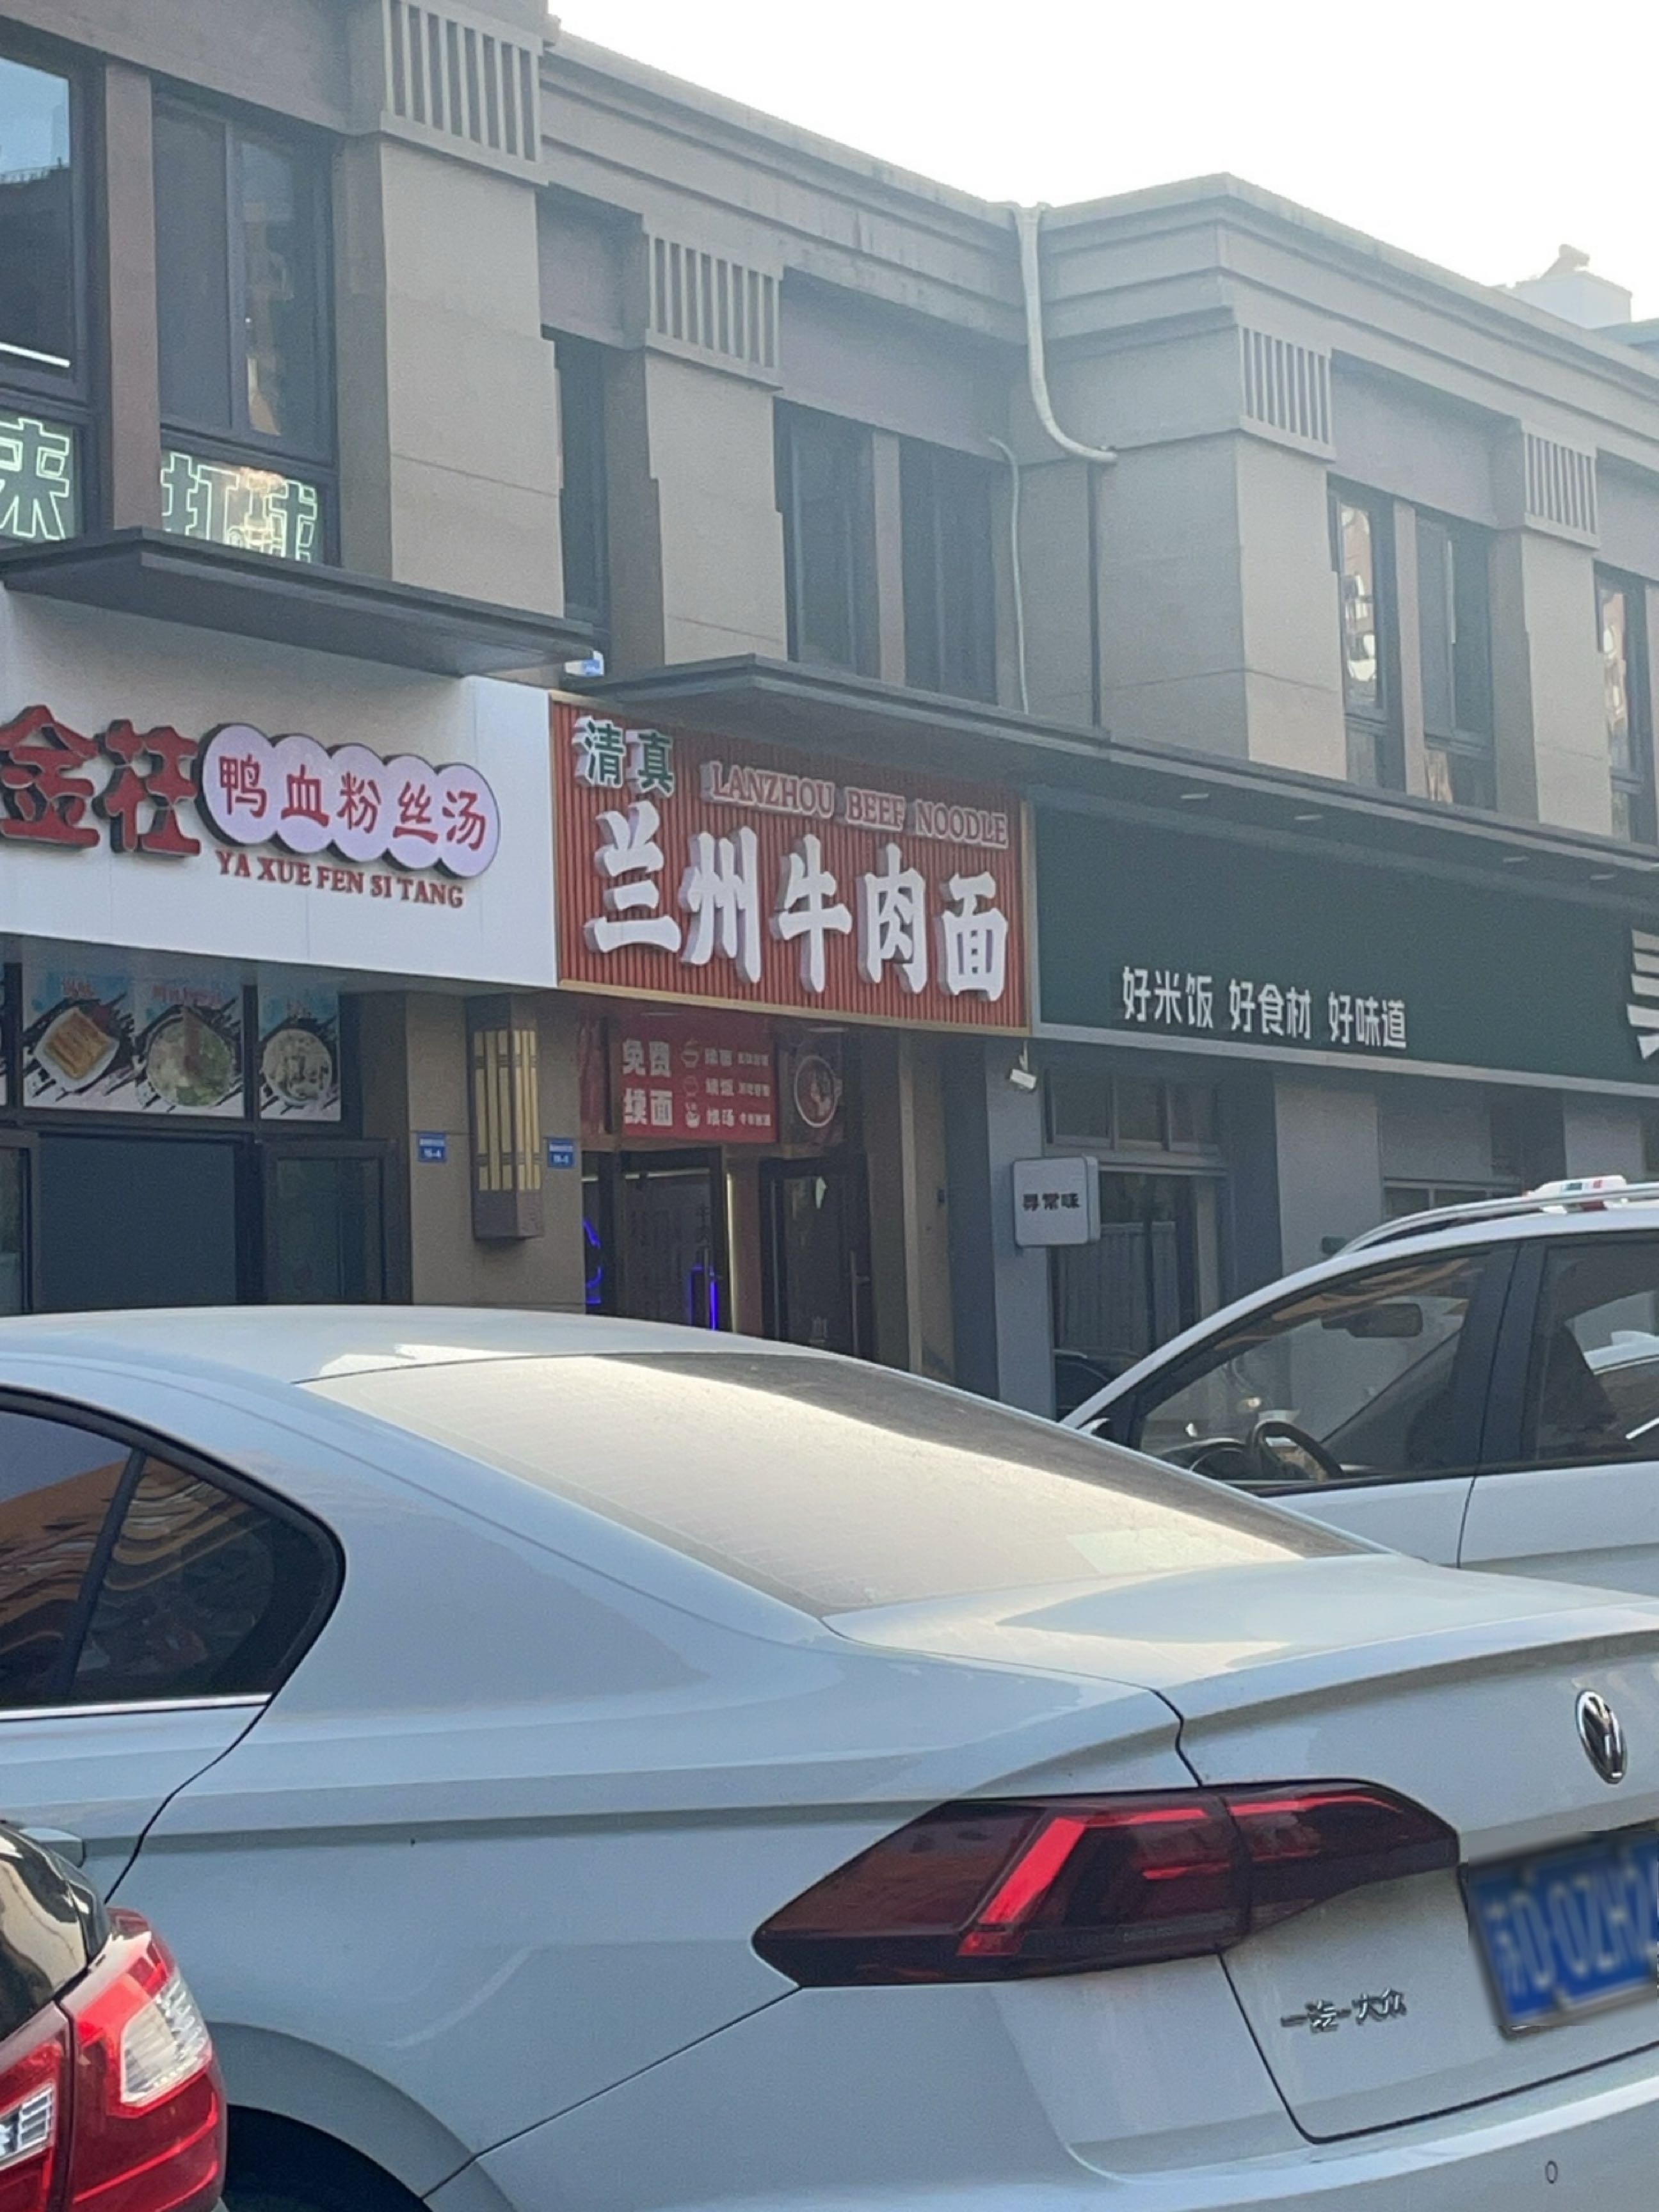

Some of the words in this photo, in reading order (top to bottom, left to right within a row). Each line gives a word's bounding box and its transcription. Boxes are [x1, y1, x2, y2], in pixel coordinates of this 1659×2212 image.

[579, 716, 674, 797] 清真
[219, 754, 486, 851] 鸭血粉丝汤
[709, 760, 835, 819] LANZHOU
[844, 787, 905, 831] BEEF
[915, 798, 1009, 849] NOODLE
[216, 850, 252, 878] YA
[257, 856, 312, 886] XUE
[316, 865, 364, 895] FEN
[370, 874, 393, 900] SI
[397, 876, 463, 909] TANG
[584, 800, 1009, 1002] 兰州牛肉面
[1122, 966, 1214, 1029] 好米饭
[1228, 977, 1311, 1040] 好食材
[1327, 990, 1407, 1050] 好味道
